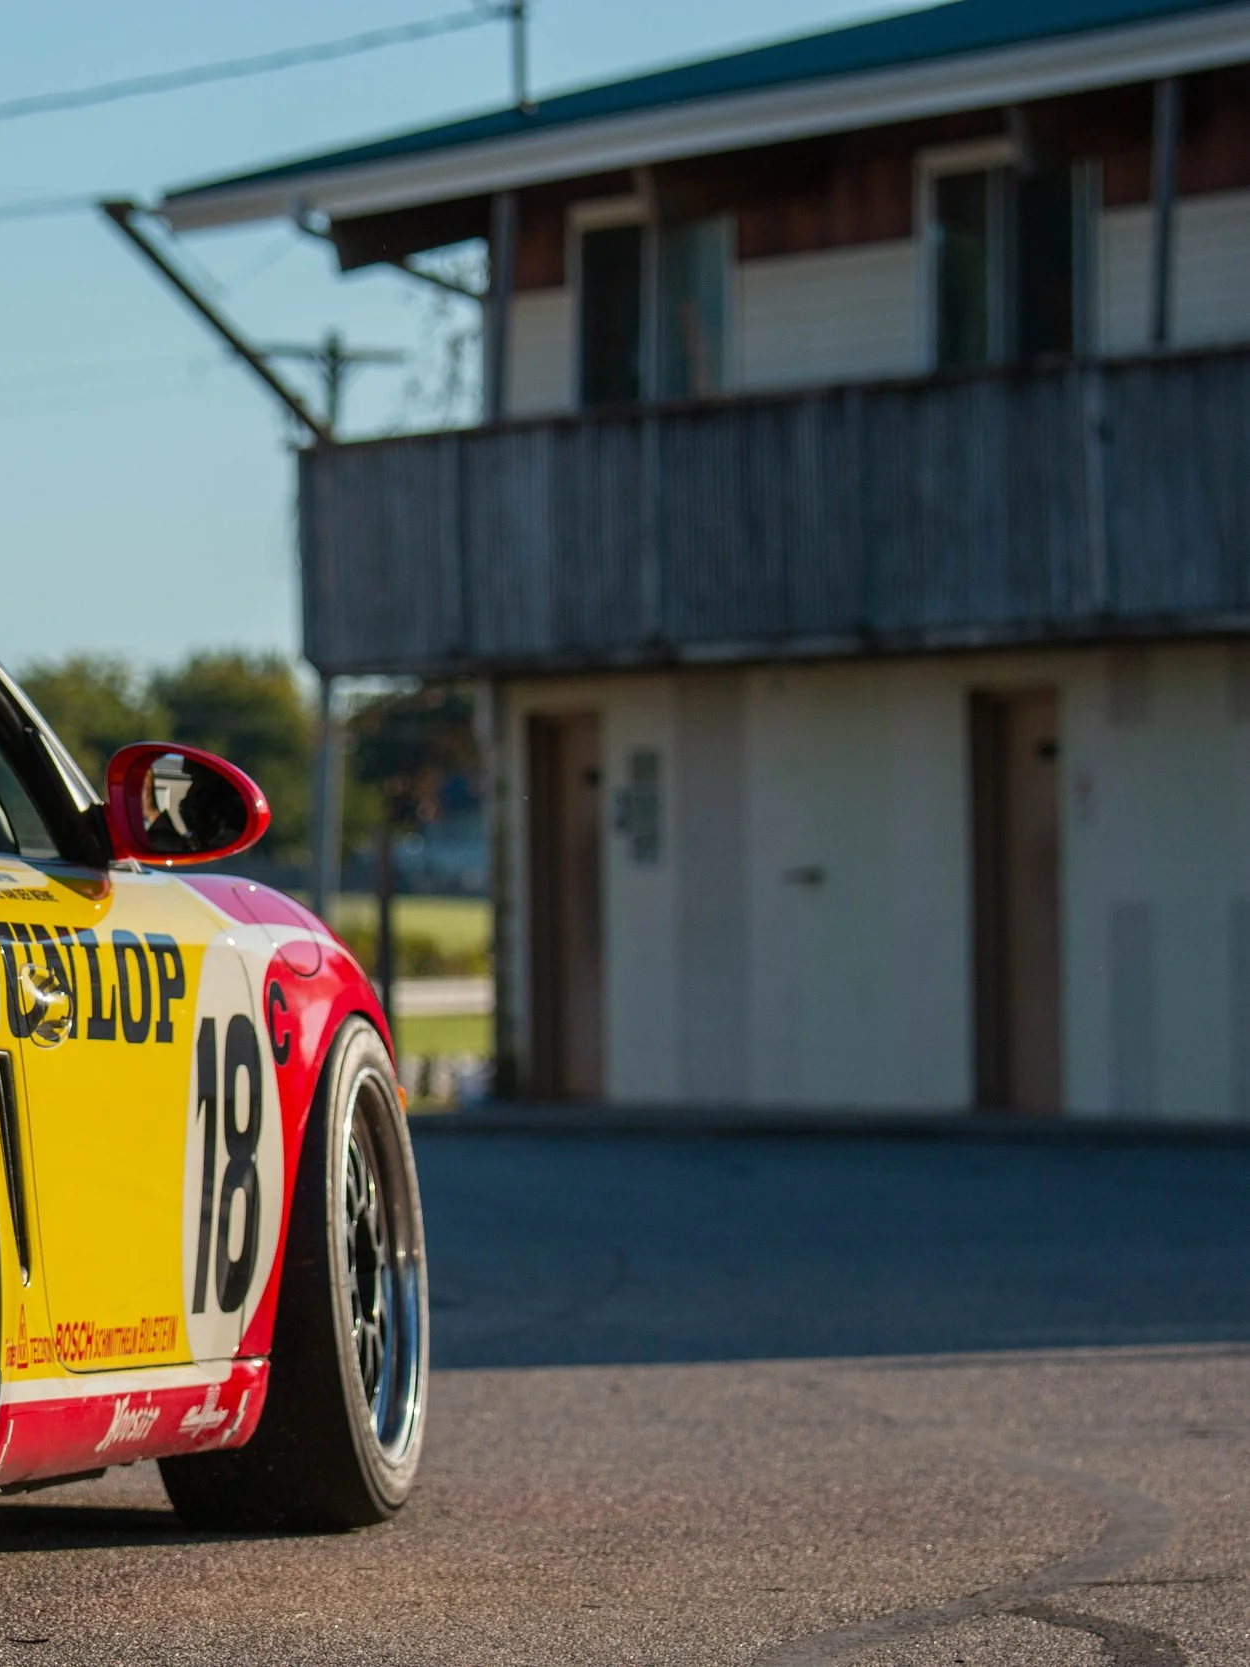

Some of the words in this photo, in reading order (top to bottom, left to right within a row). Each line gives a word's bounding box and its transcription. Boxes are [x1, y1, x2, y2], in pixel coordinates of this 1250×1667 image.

[268, 980, 292, 1067] C
[192, 1014, 262, 1313] 18
[55, 1321, 95, 1362] BOSCH
